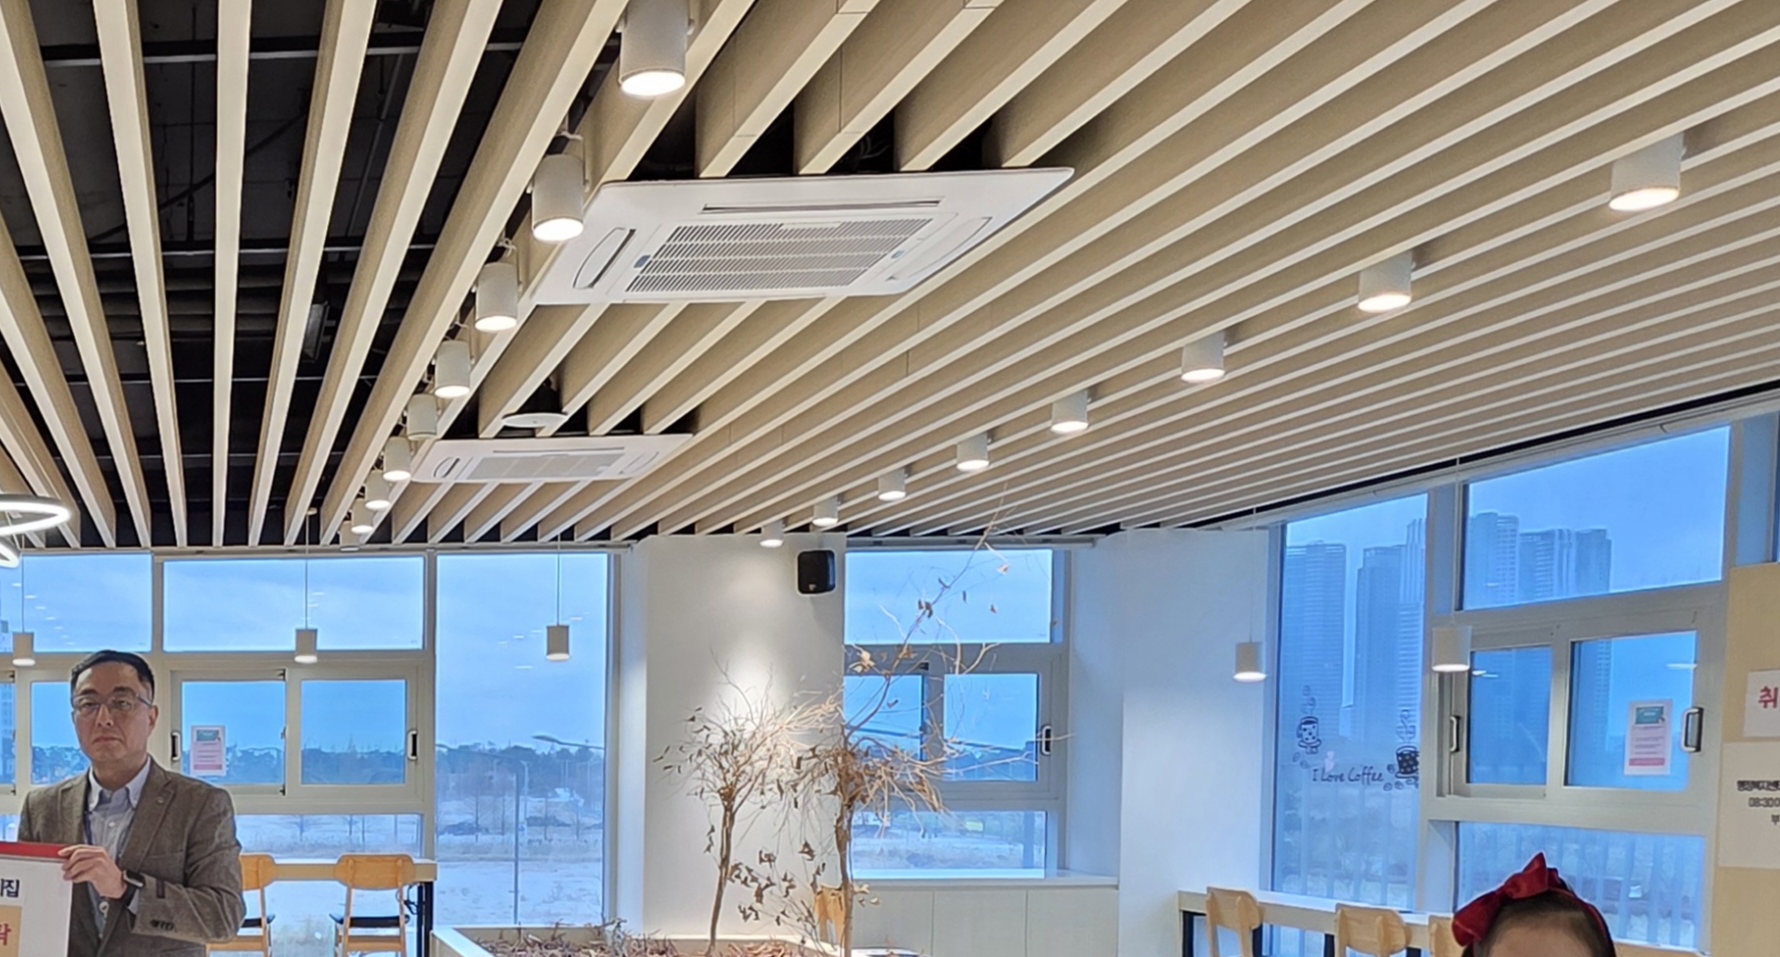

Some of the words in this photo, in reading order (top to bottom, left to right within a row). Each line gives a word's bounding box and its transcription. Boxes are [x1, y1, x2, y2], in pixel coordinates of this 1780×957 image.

[1312, 768, 1319, 781] I
[1321, 768, 1346, 782] Love
[1347, 766, 1384, 785] Coffee
